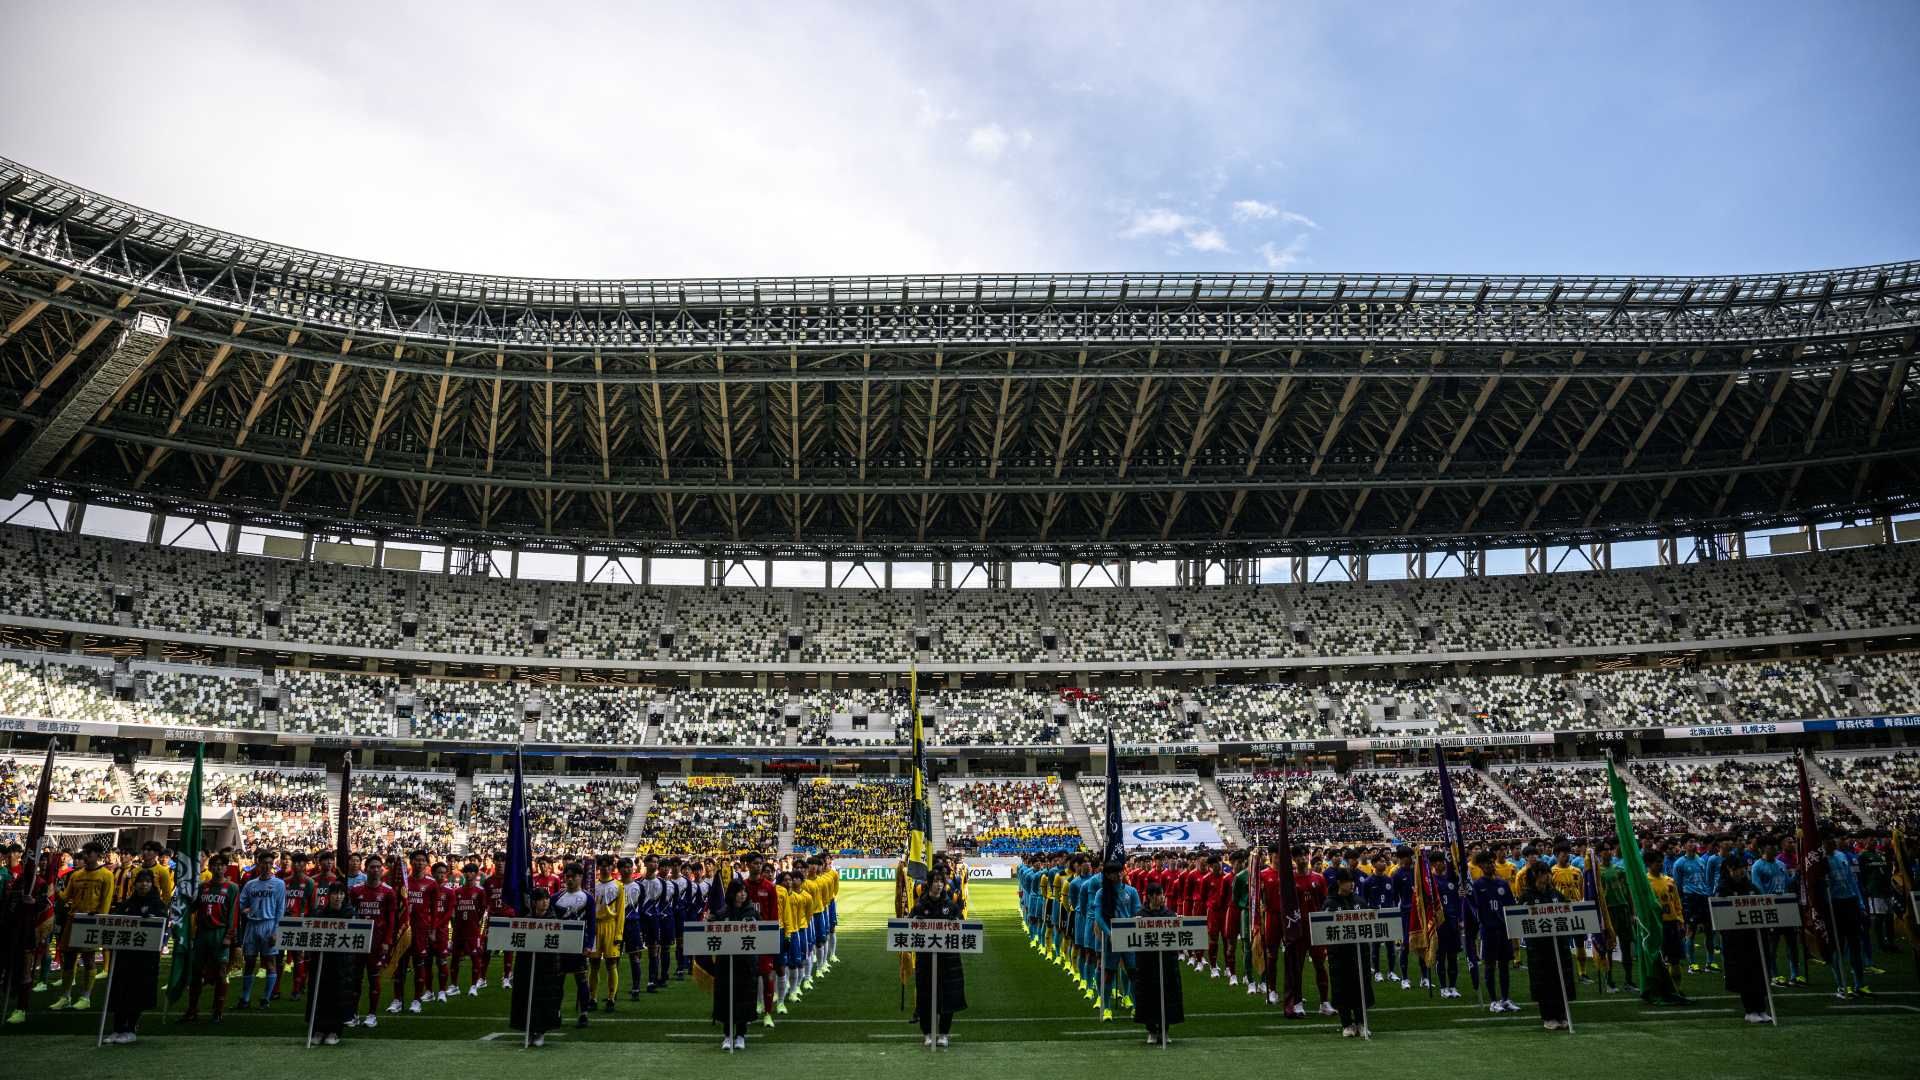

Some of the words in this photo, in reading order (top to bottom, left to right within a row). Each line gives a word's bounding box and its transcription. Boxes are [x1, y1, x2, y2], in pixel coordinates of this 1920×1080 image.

[37, 721, 81, 734] 徳島市立
[1689, 725, 1733, 737] 北海道代表
[1741, 723, 1777, 734] 札幌大谷
[1835, 718, 1875, 729] 青森代表
[1249, 743, 1283, 753] 沖縄代表
[1389, 740, 1401, 748] ALL
[1402, 739, 1423, 748] JAPAN
[1423, 738, 1435, 747] HIG
[1439, 738, 1464, 747] SCHOOL
[1465, 737, 1490, 746] SOCCER
[1491, 735, 1532, 746] TOURNAMENT
[1158, 745, 1200, 755] 鹿児島城西
[110, 804, 150, 817] GATE
[154, 805, 163, 817] 5
[838, 867, 896, 880] FUJIFILM
[1489, 899, 1500, 912] 10
[1734, 896, 1773, 908] 長野県代表
[1335, 911, 1377, 921] 新潟県代表
[1531, 905, 1571, 916] 富山県代表
[1735, 908, 1779, 926] 上田西
[97, 918, 139, 928] 埼玉県代表
[303, 920, 346, 930] 千葉県代表
[511, 921, 562, 931] 東京都A代表
[706, 924, 757, 933] 東京都B代表
[911, 921, 961, 931] 神奈川県代表
[1138, 919, 1181, 929] 山梨県代表
[1520, 915, 1586, 935] 龍谷富山
[83, 928, 148, 947] 正智深谷
[1325, 922, 1390, 941] 新潟明訓
[280, 931, 366, 949] 流通経済大柏
[893, 933, 977, 950] 東海大相模
[1127, 931, 1194, 948] 山梨学院
